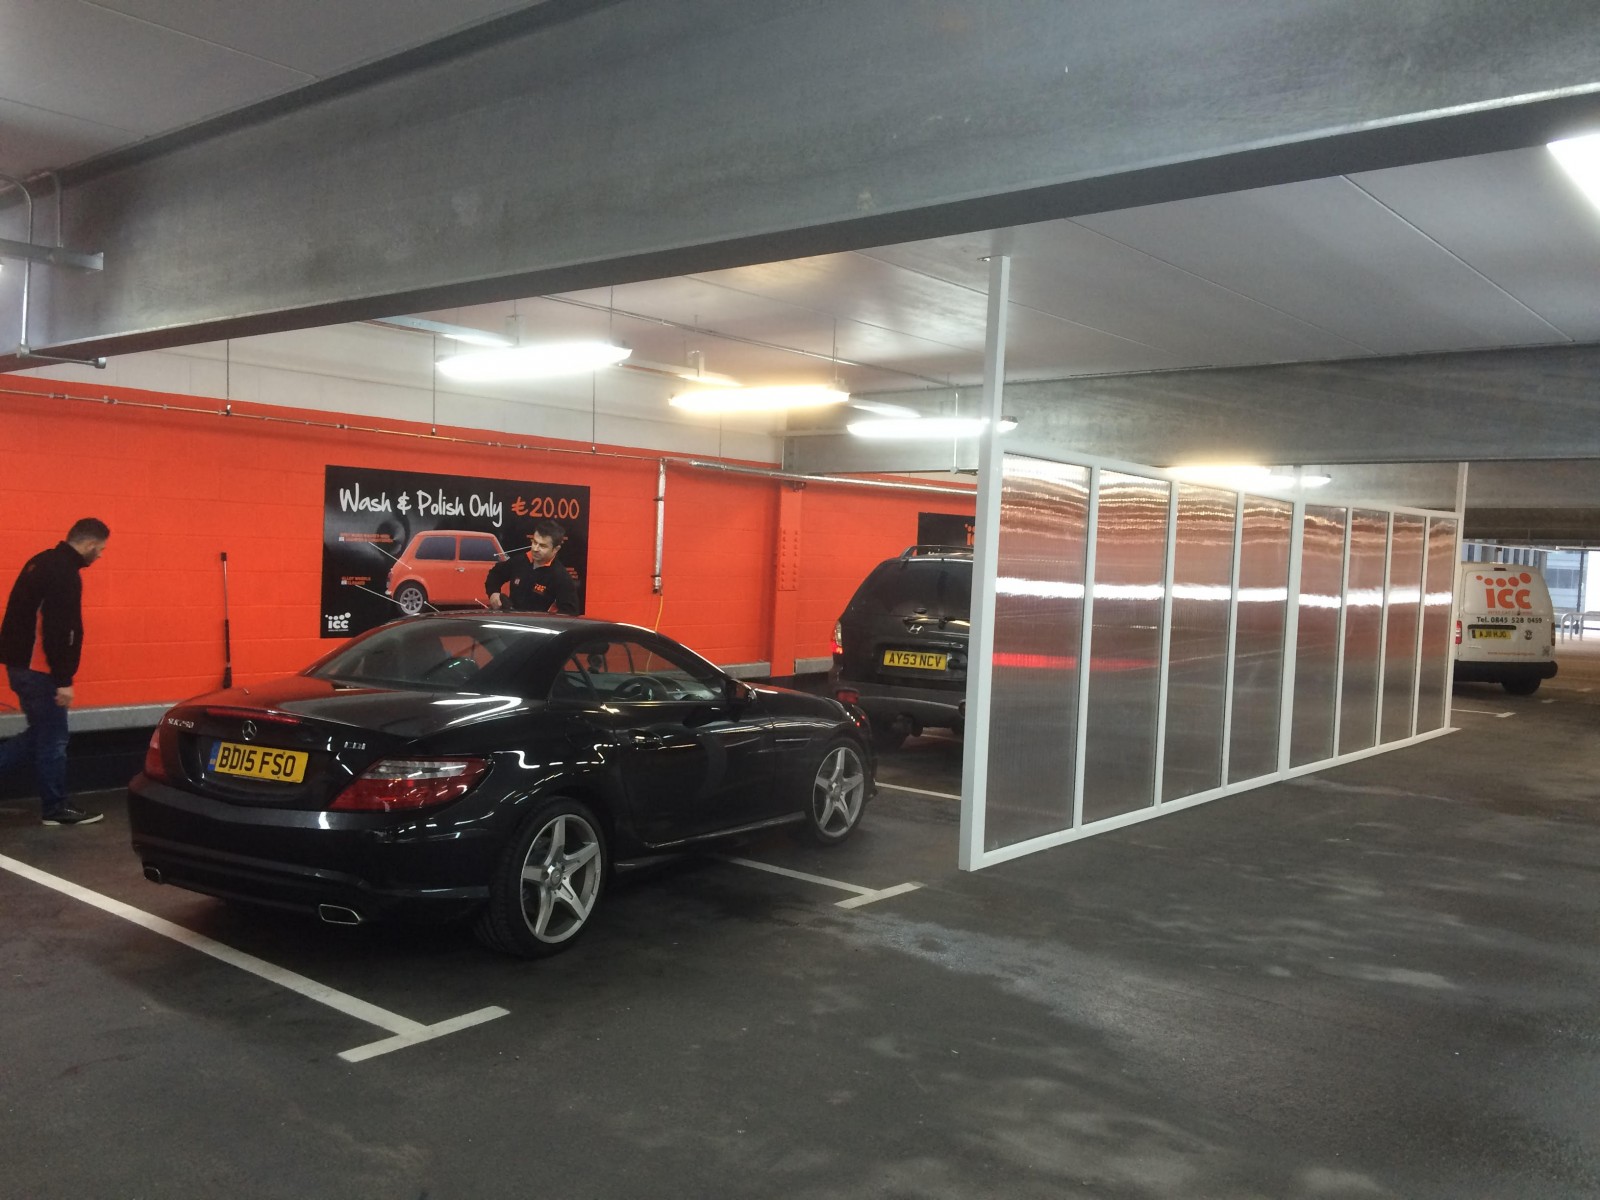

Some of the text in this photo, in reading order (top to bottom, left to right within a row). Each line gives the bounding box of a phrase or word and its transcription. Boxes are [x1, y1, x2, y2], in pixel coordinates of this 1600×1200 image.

[339, 482, 392, 513] Wash
[397, 491, 412, 516] &
[416, 488, 465, 518] Polish
[469, 491, 503, 528] Only
[1511, 616, 1525, 624] 528
[889, 653, 942, 667] AY53 NCV
[218, 746, 297, 777] BD15 FSO
